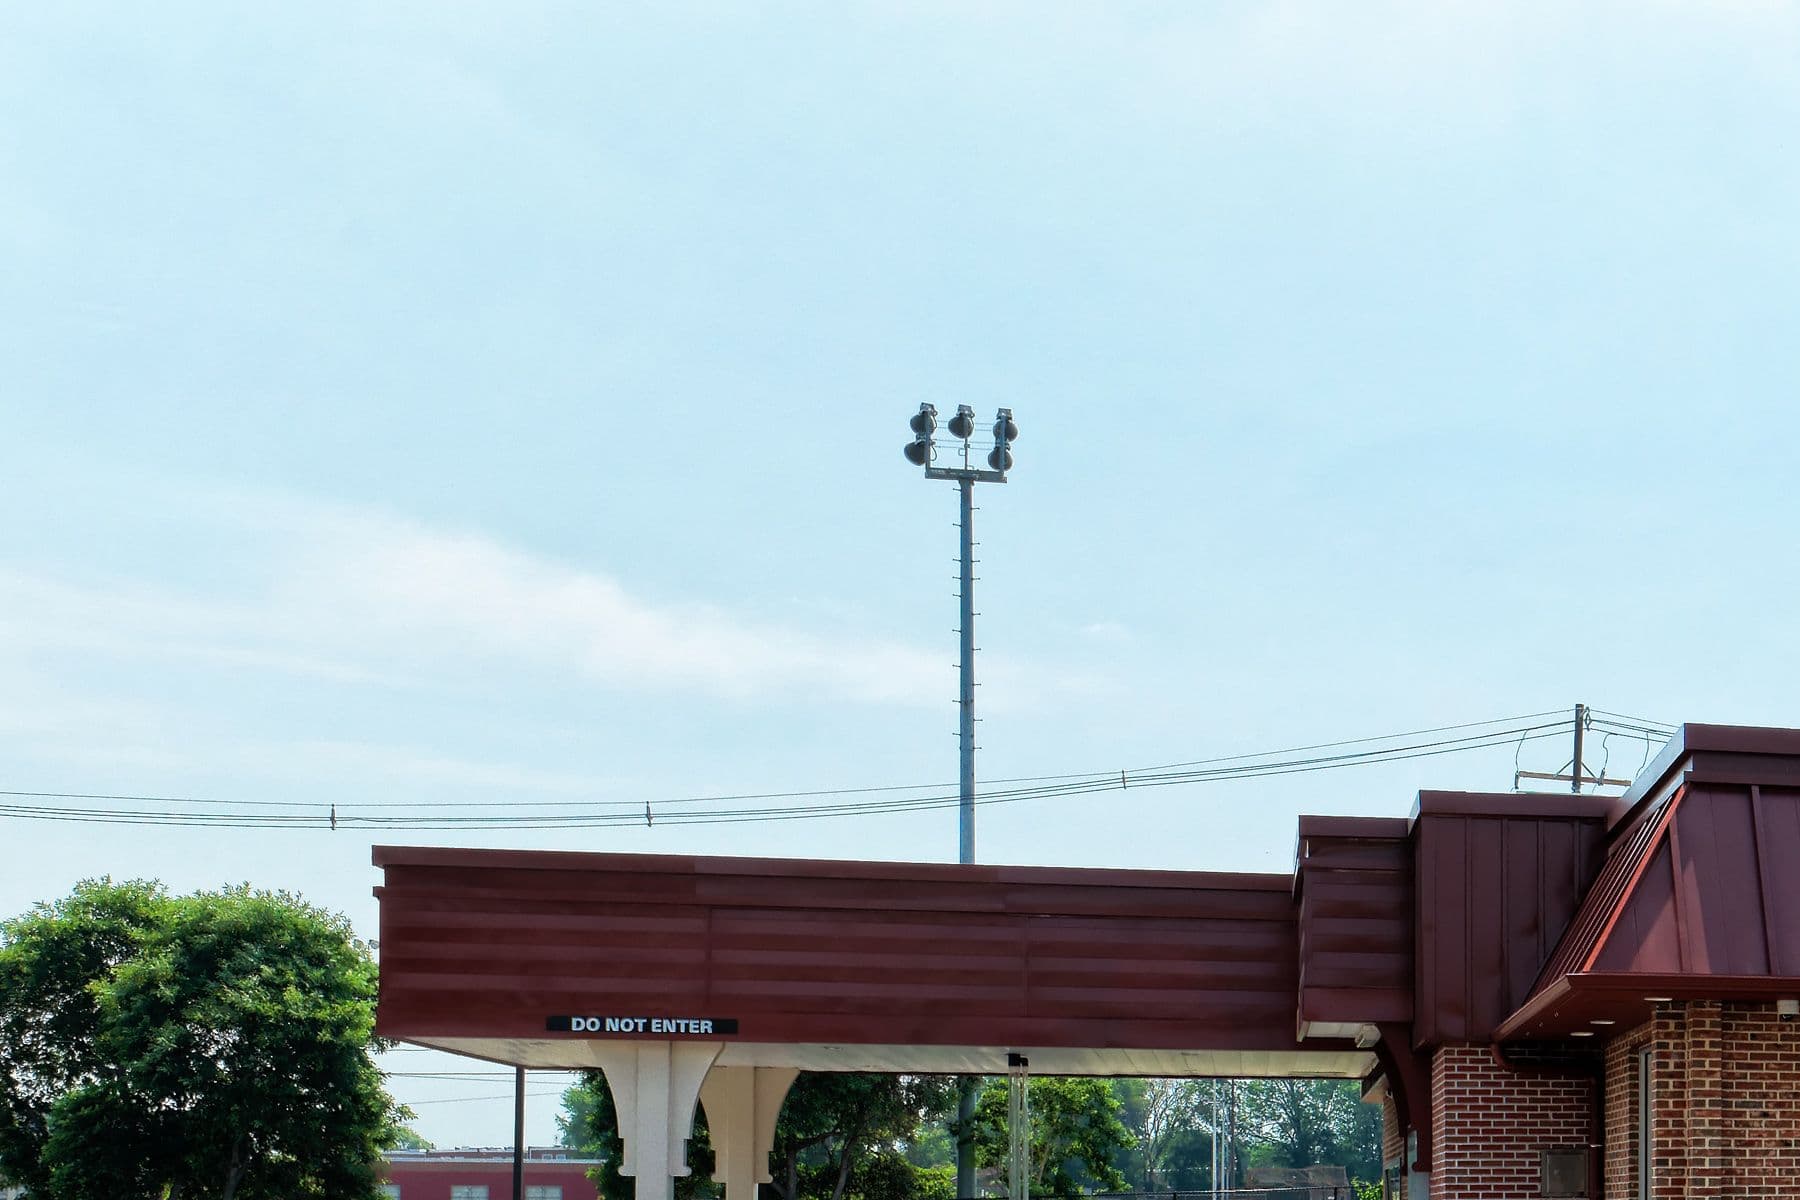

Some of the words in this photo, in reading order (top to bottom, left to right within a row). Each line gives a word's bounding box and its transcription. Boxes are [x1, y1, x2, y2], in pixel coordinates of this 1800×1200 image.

[571, 1017, 600, 1032] DO
[605, 1018, 647, 1033] NOT
[651, 1019, 713, 1034] ENTER
